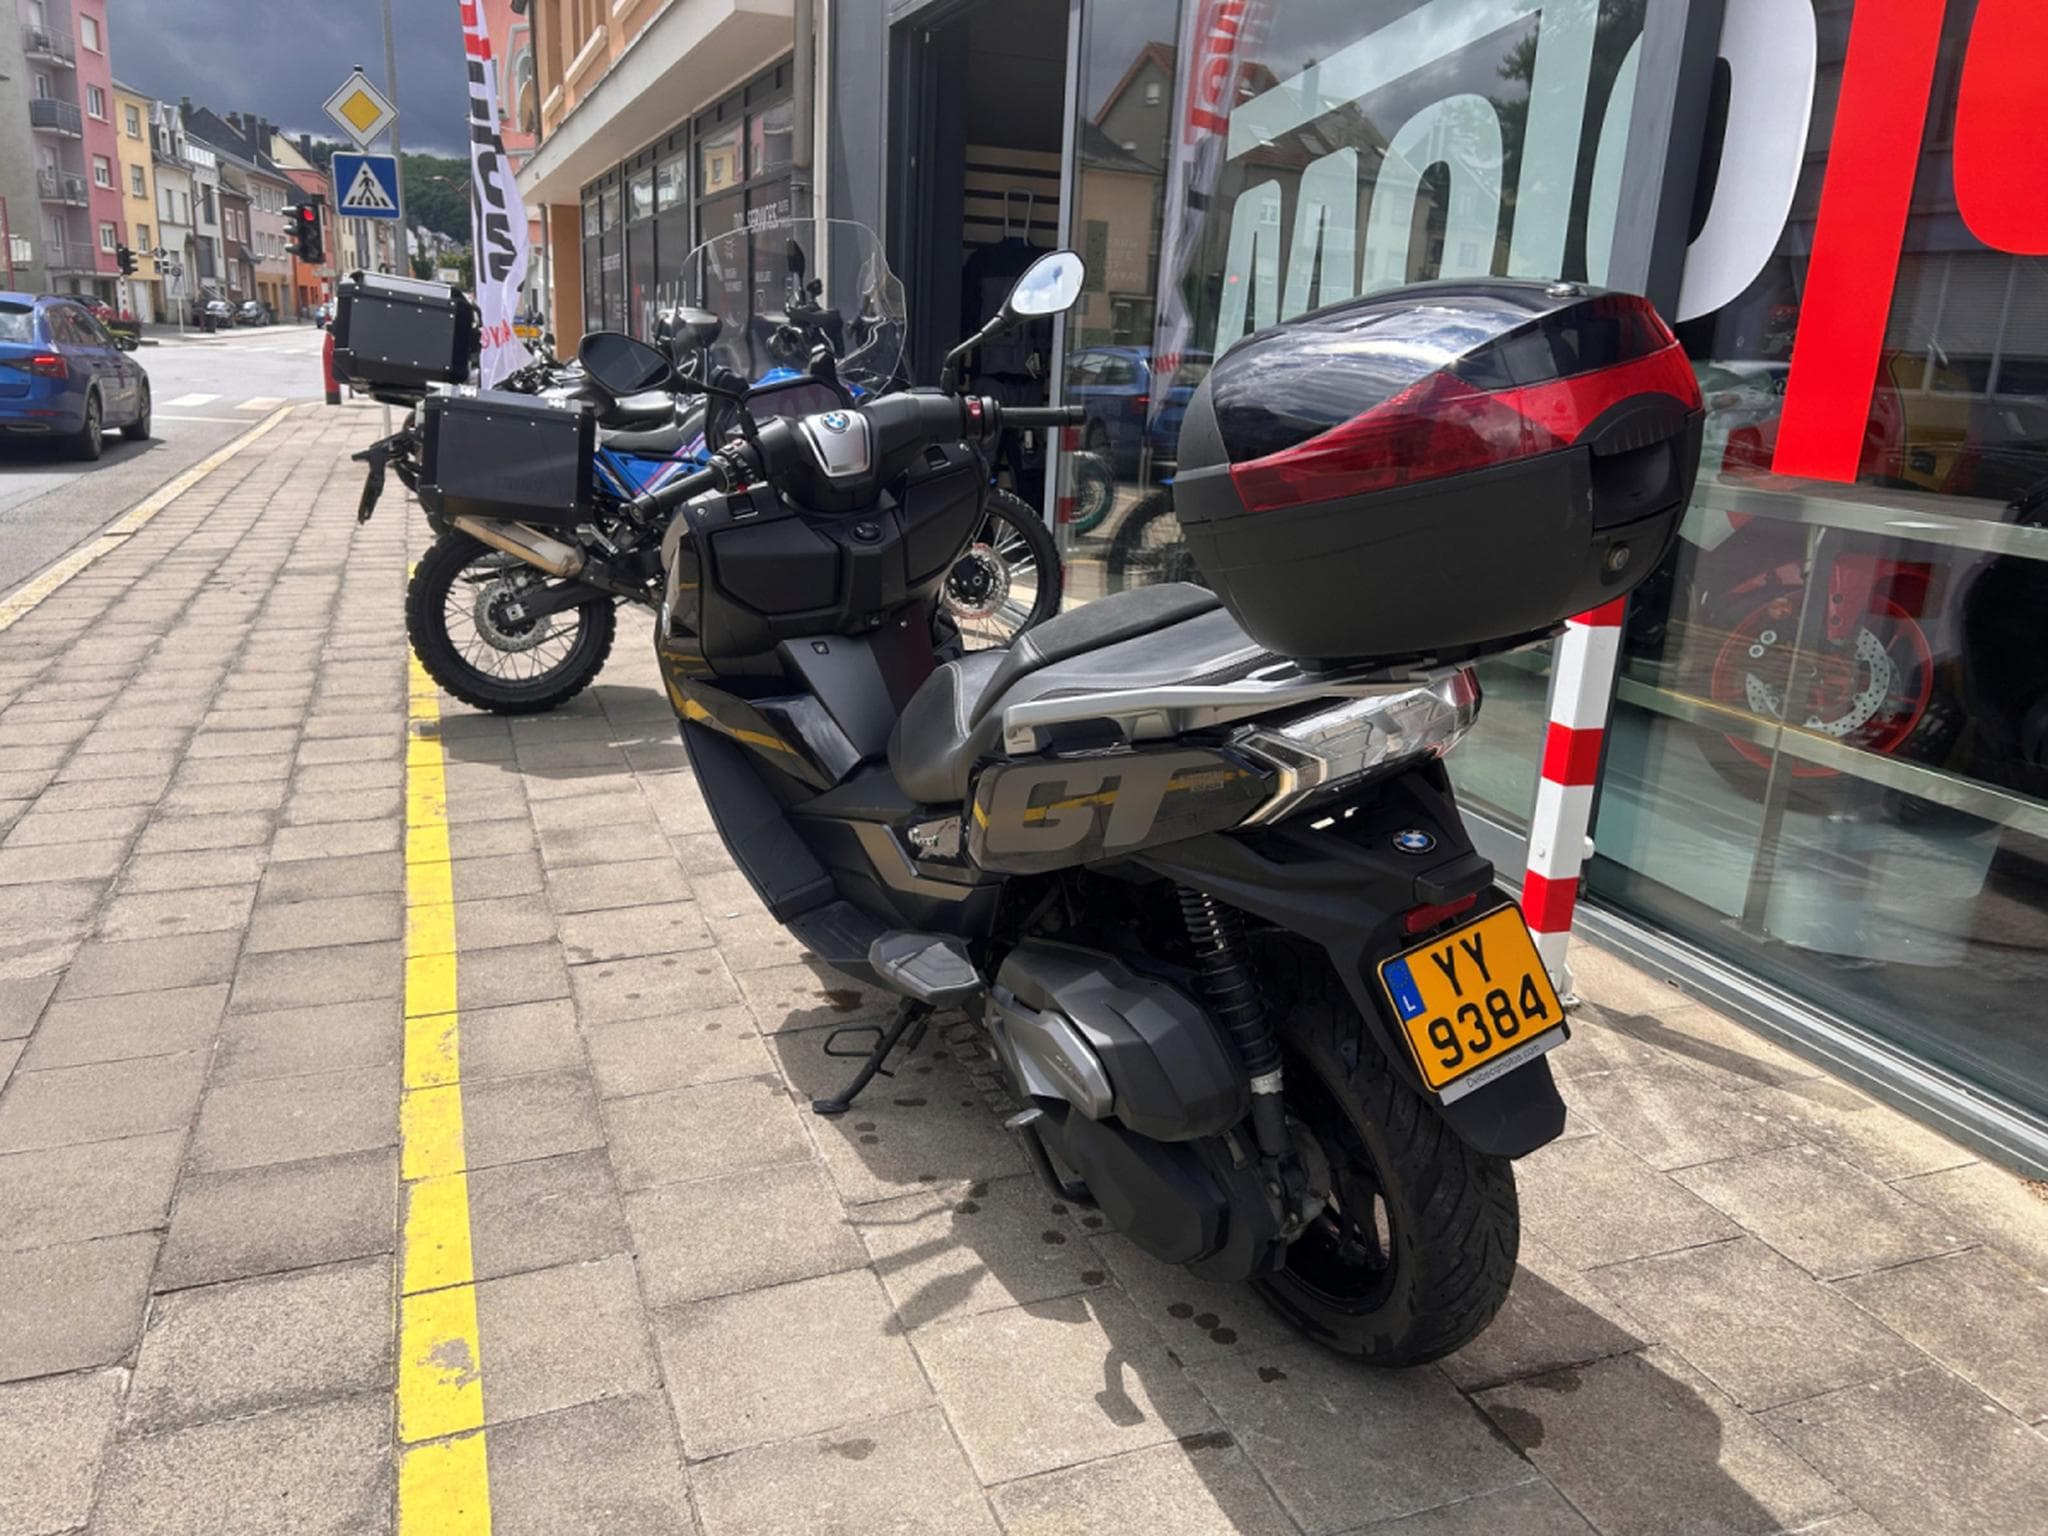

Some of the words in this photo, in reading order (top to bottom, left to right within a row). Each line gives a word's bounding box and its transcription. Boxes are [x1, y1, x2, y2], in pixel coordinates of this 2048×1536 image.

[985, 748, 1227, 853] GT
[1402, 996, 1417, 1013] L
[1430, 932, 1491, 997] YY
[1427, 973, 1549, 1070] 9384
